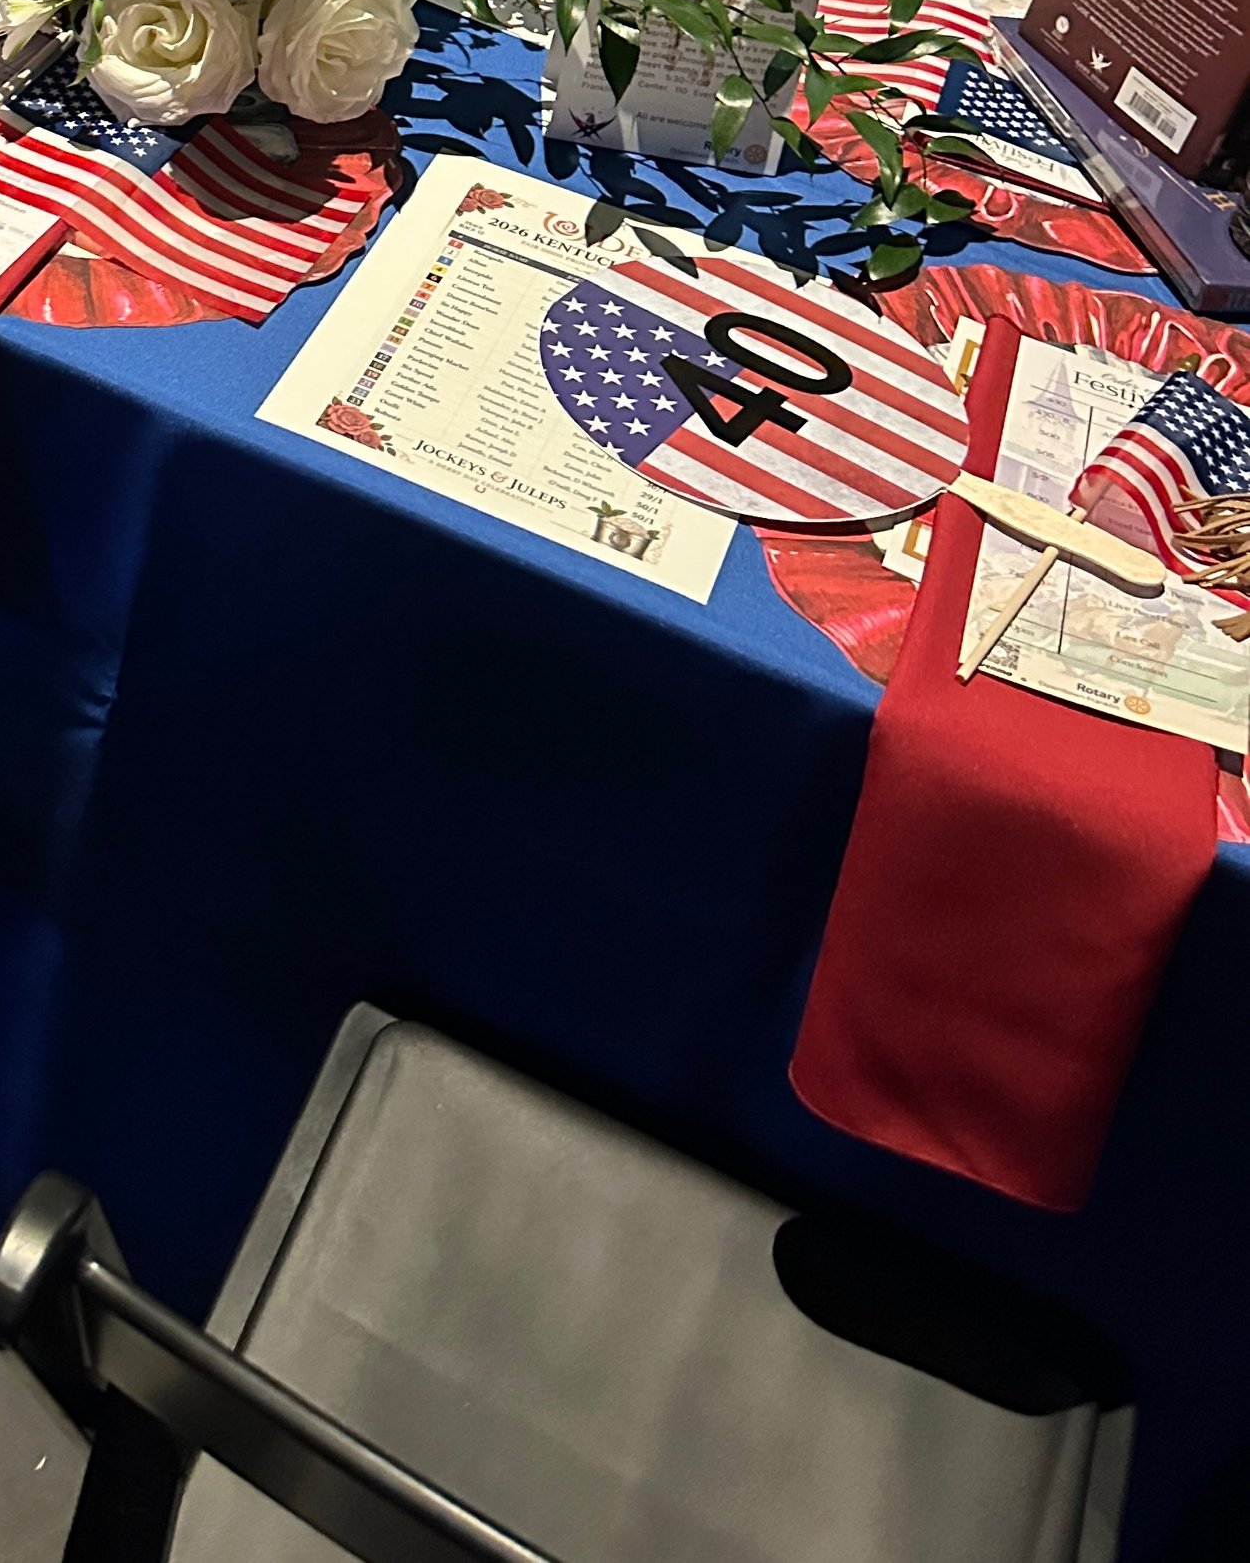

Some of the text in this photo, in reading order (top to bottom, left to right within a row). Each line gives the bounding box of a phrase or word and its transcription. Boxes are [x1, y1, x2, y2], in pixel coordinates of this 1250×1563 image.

[488, 218, 528, 237] 2026
[533, 234, 615, 269] KENTUC
[660, 312, 853, 448] 40
[1074, 371, 1146, 406] Festiv
[413, 440, 566, 509] JOCKEYS & JULEPS
[632, 512, 654, 525] 50/1
[635, 501, 659, 515] 50/1
[1077, 683, 1120, 704] Rotary
